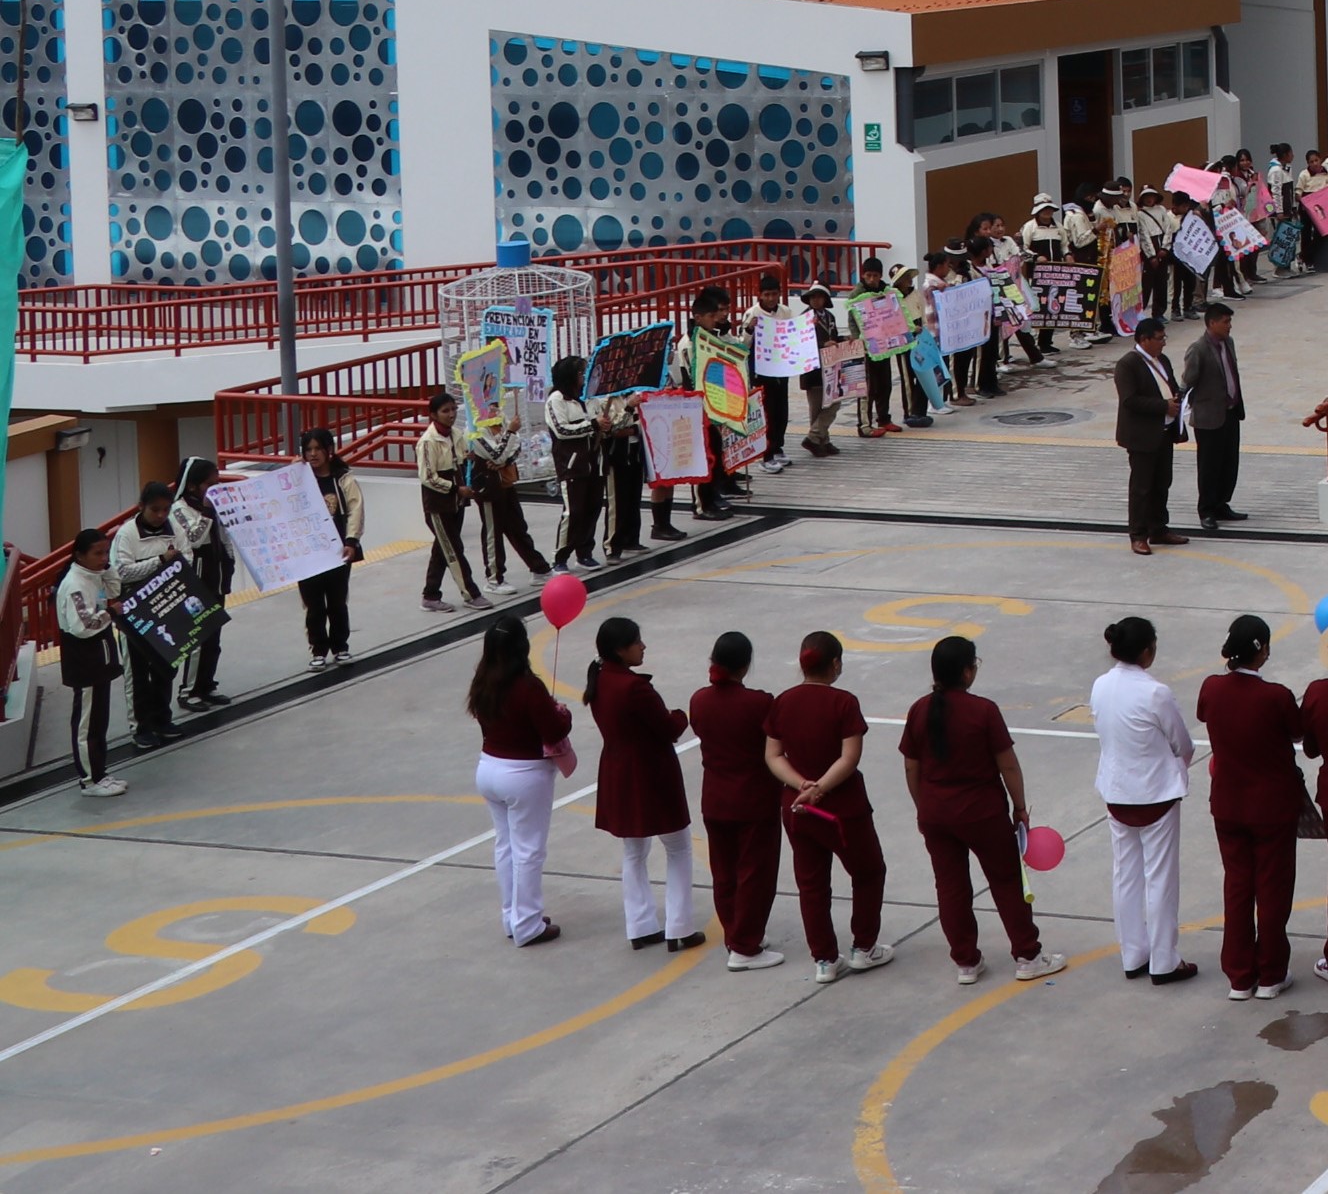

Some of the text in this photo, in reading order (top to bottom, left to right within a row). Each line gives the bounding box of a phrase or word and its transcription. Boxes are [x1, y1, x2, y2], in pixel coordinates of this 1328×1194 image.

[537, 315, 547, 326] DE
[528, 328, 539, 339] EN
[523, 365, 538, 376] TES
[136, 561, 182, 600] TIEMPO
